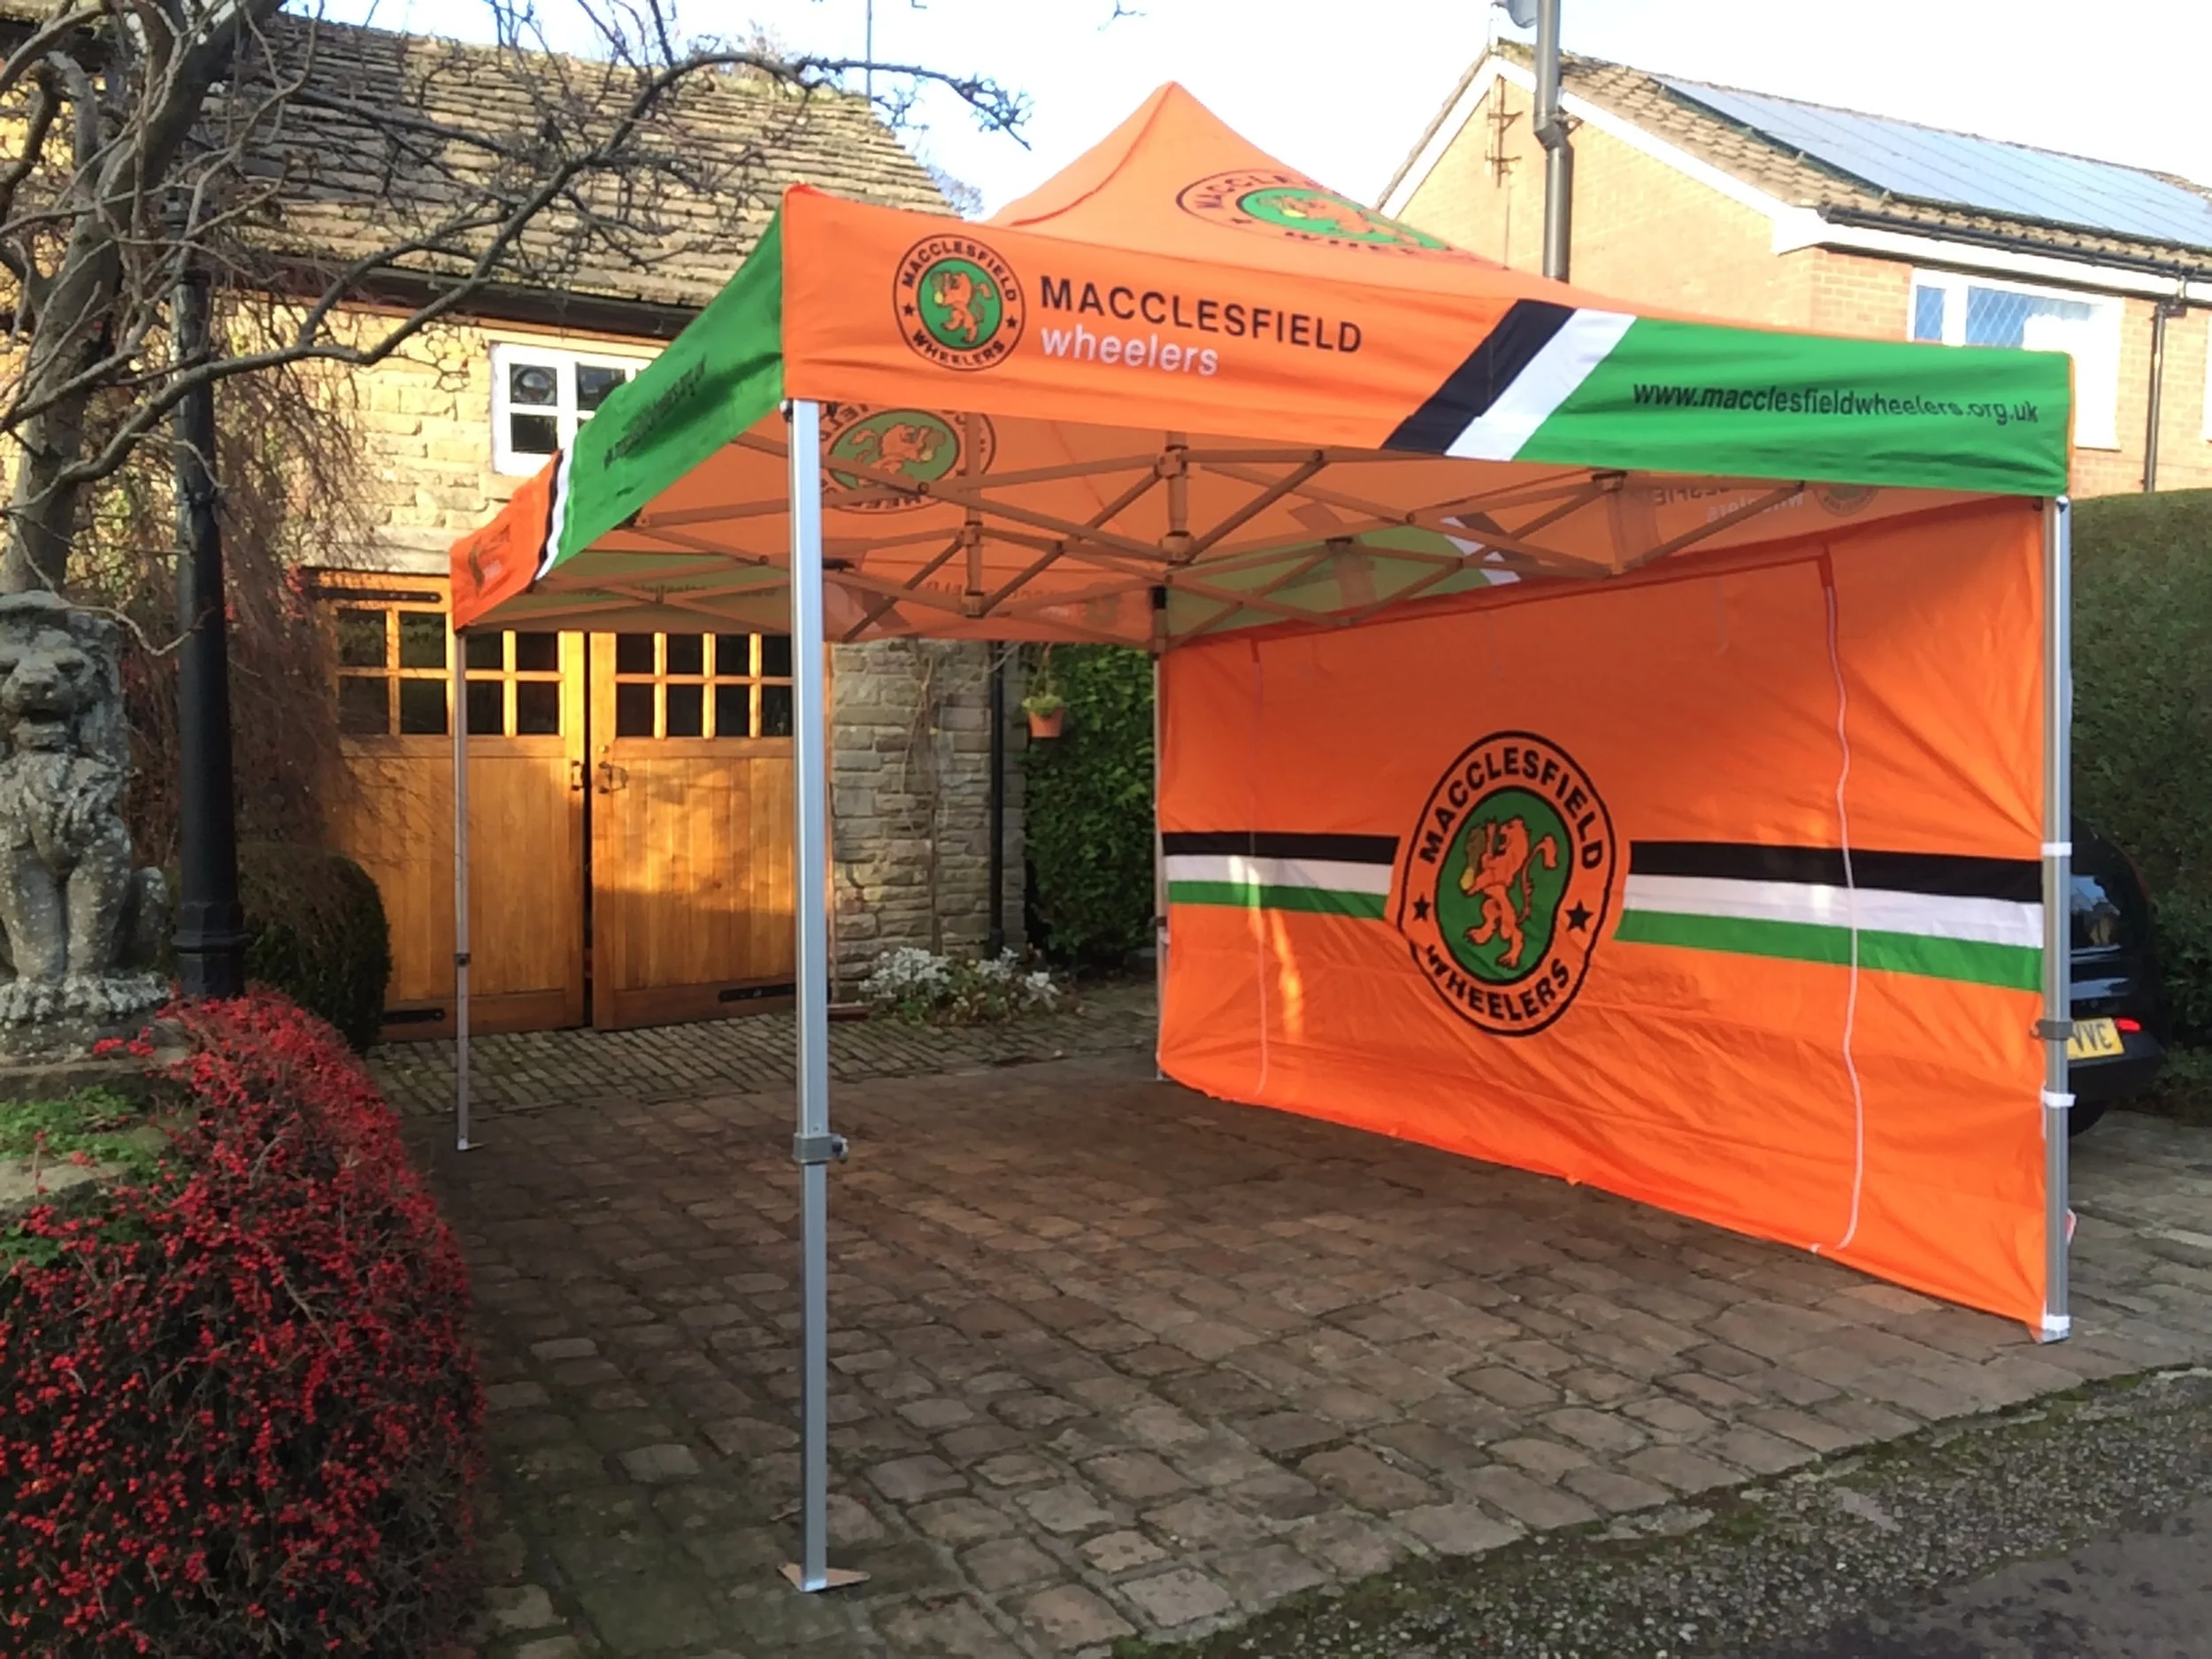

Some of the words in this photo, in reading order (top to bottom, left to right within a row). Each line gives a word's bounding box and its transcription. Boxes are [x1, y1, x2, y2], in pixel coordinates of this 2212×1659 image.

[902, 241, 1017, 302] MACCLESFIELD
[1041, 275, 1362, 353] MACCLESFIELD
[913, 328, 1005, 365] WHEELERS
[1041, 324, 1218, 376] wheelers
[1632, 383, 2039, 425] www.macclesfieldwheelers.org.uk
[1419, 747, 1603, 870] MACCLESFIELD
[1425, 944, 1570, 1020] WHEELERS
